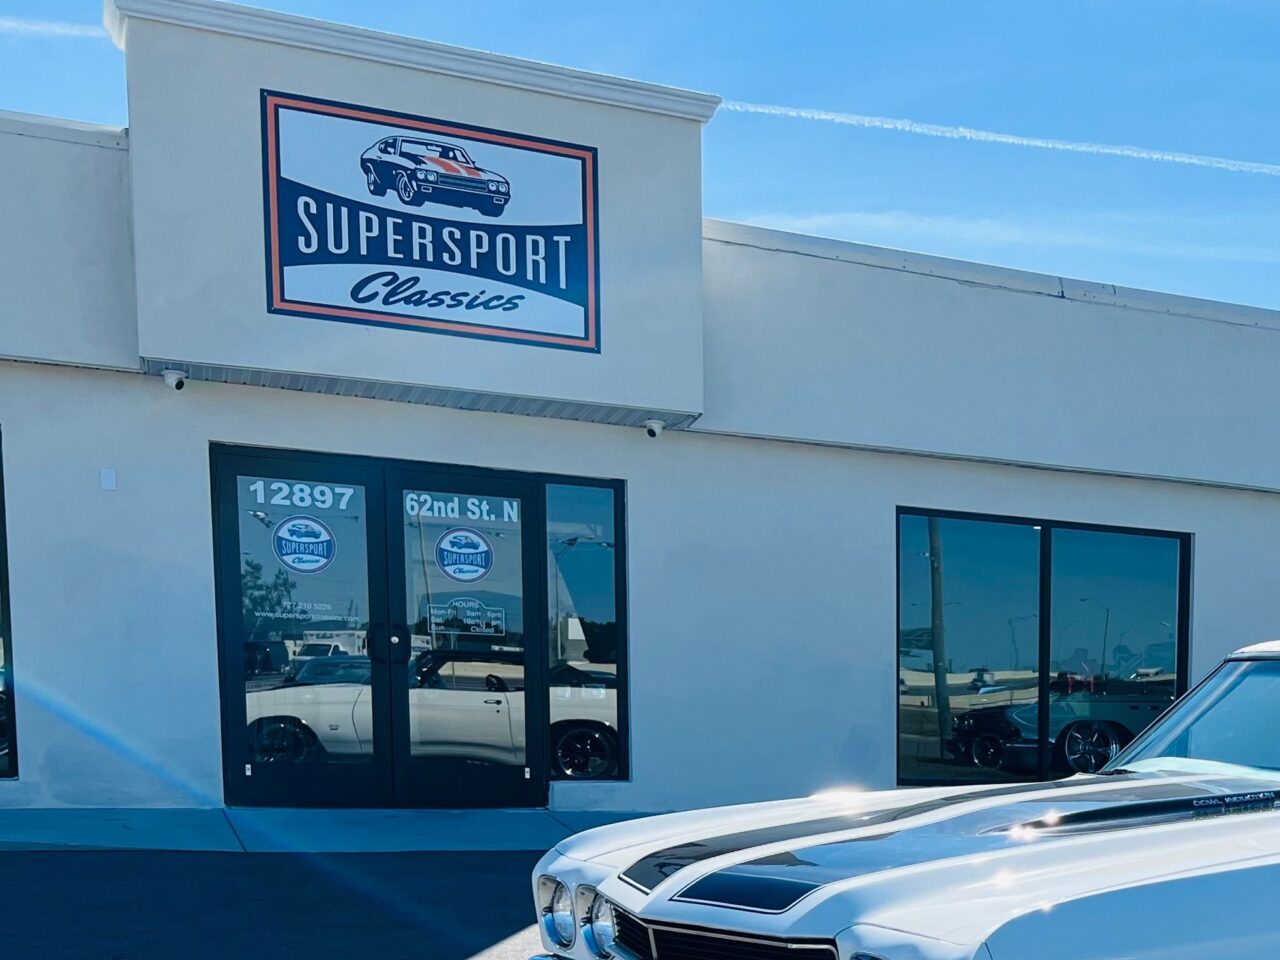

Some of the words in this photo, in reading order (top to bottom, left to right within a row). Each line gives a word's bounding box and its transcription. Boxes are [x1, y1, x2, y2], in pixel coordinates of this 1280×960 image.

[297, 196, 571, 289] SUPERSPORT
[350, 271, 526, 312] Classics
[249, 480, 354, 509] 12897
[405, 493, 459, 518] 62nd
[466, 497, 496, 520] St.
[503, 500, 518, 522] N
[281, 539, 327, 556] SUPERSPORT
[443, 551, 485, 566] SUPERSPORT
